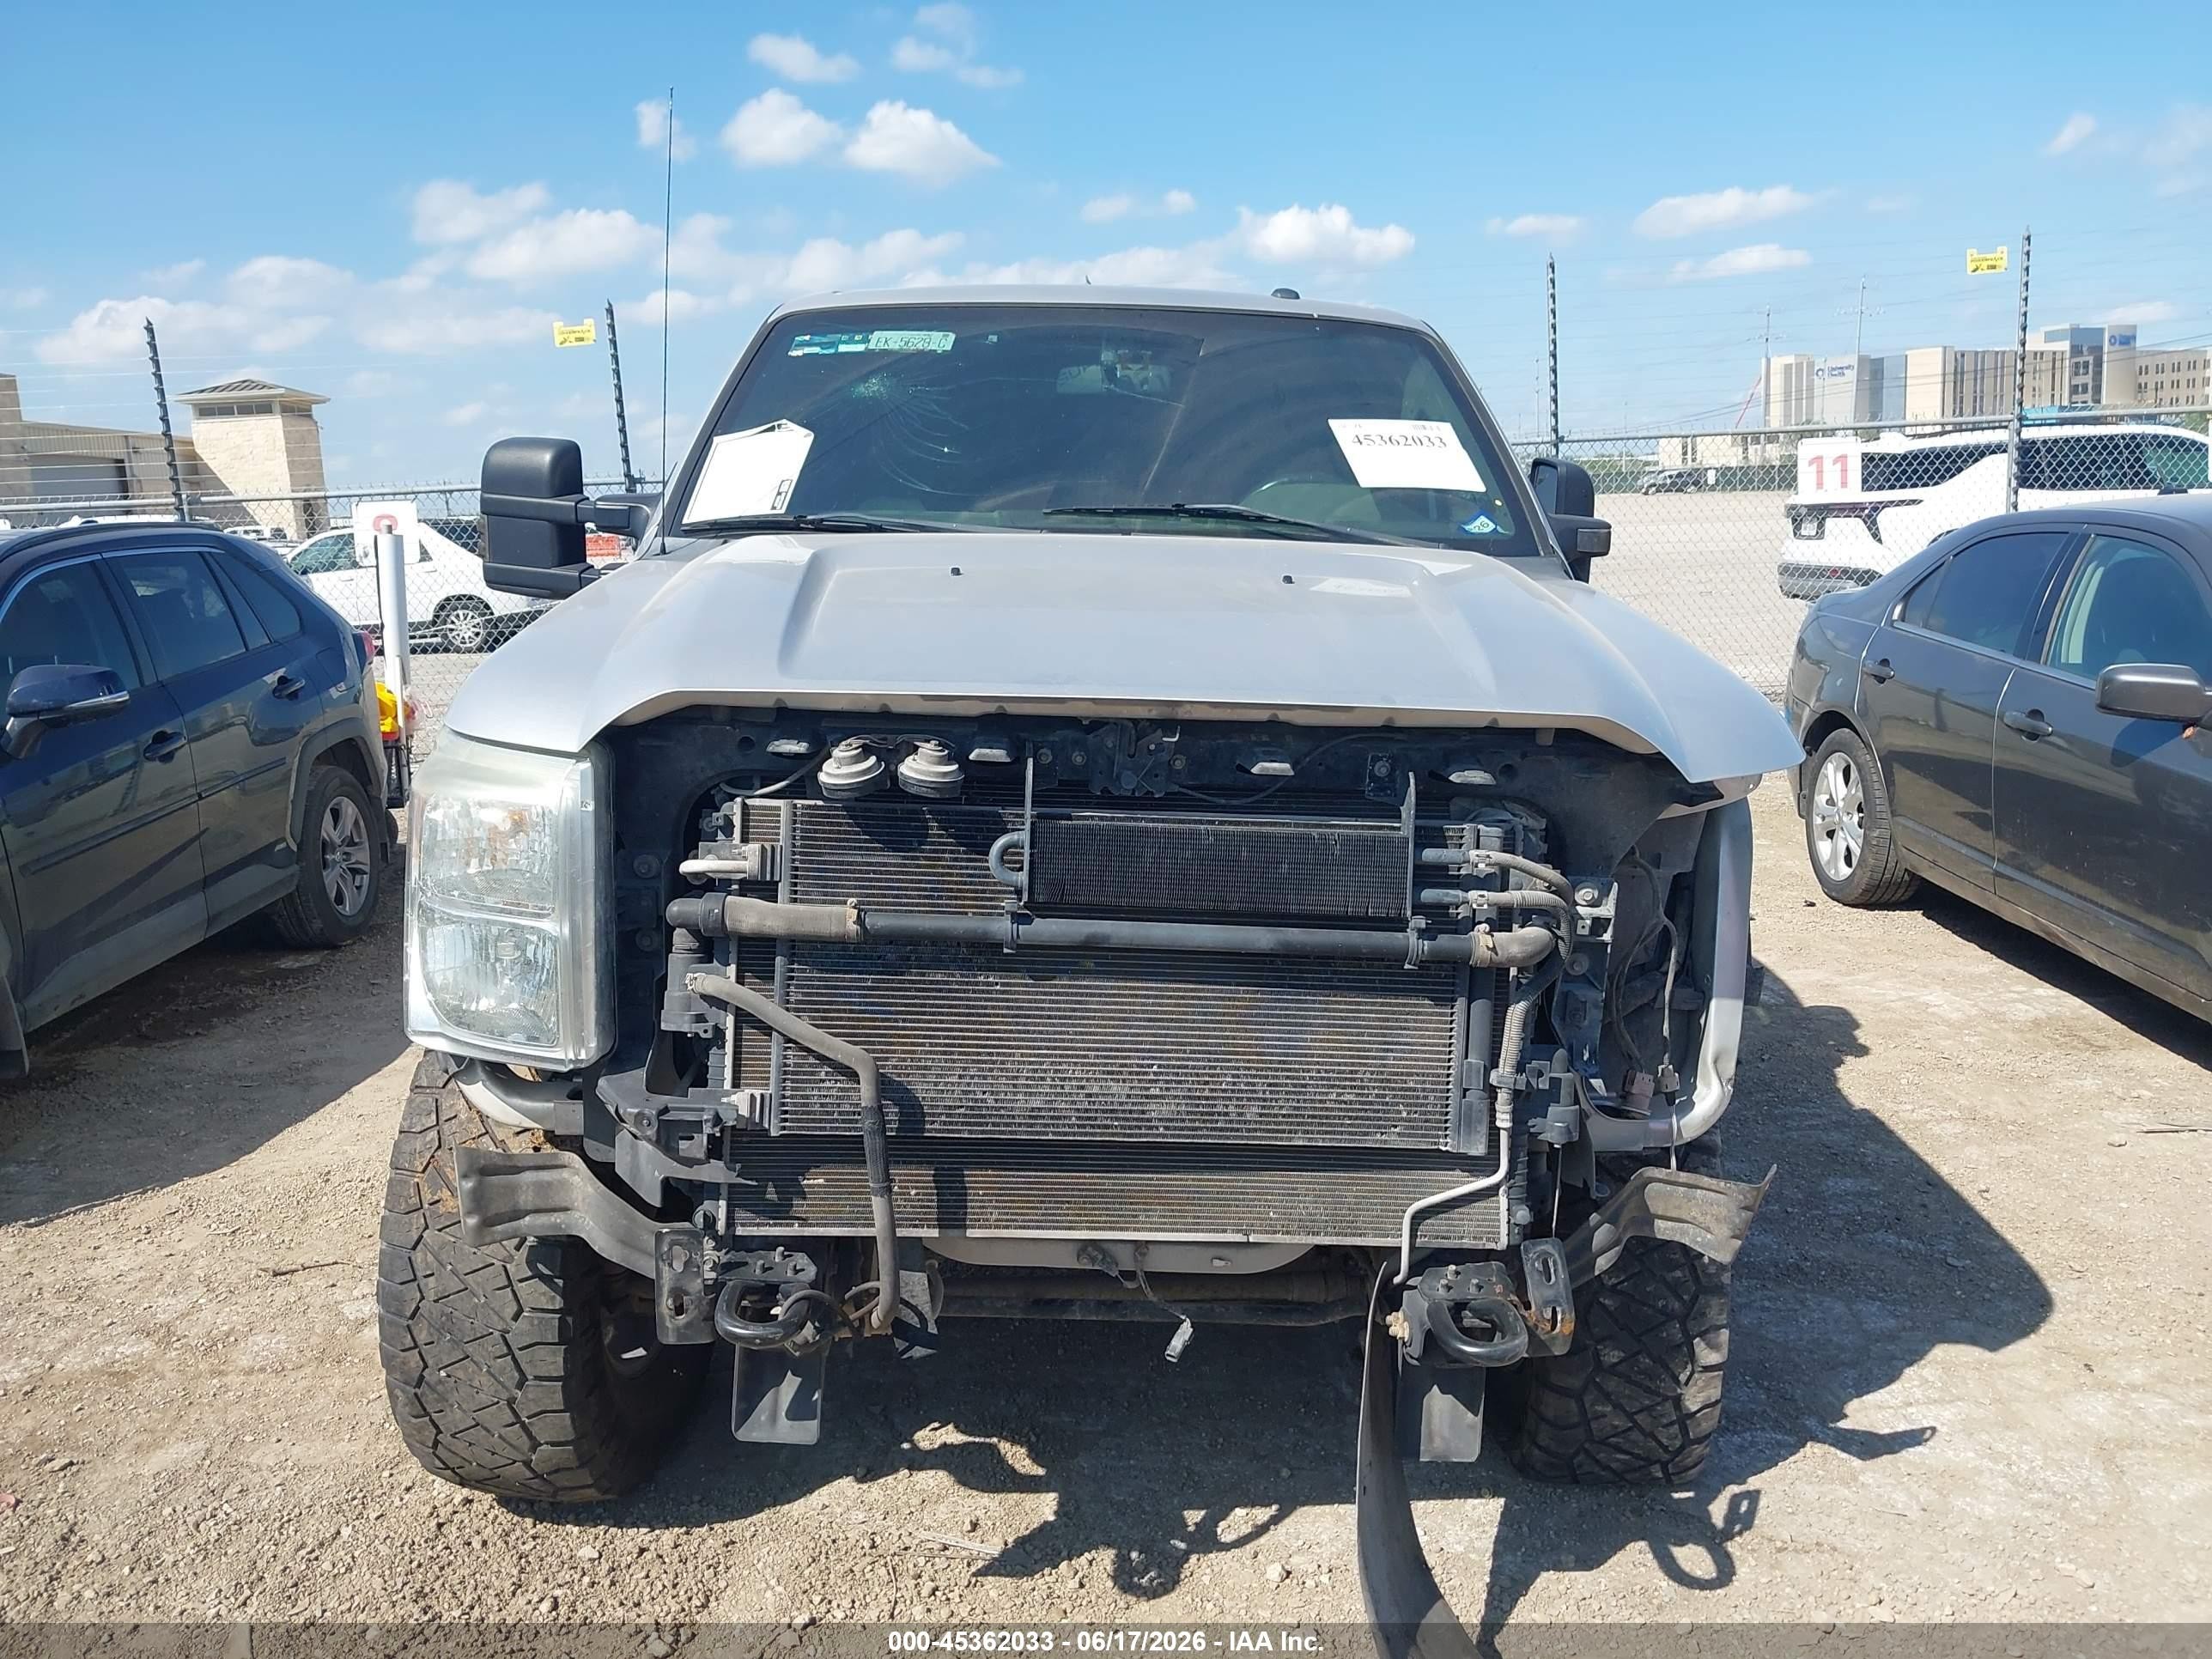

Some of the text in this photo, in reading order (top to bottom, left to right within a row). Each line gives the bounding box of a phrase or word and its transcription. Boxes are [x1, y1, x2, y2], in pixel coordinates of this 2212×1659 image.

[1352, 434, 1447, 448] 45362033
[1808, 453, 1848, 490] 11
[1474, 520, 1490, 531] 26
